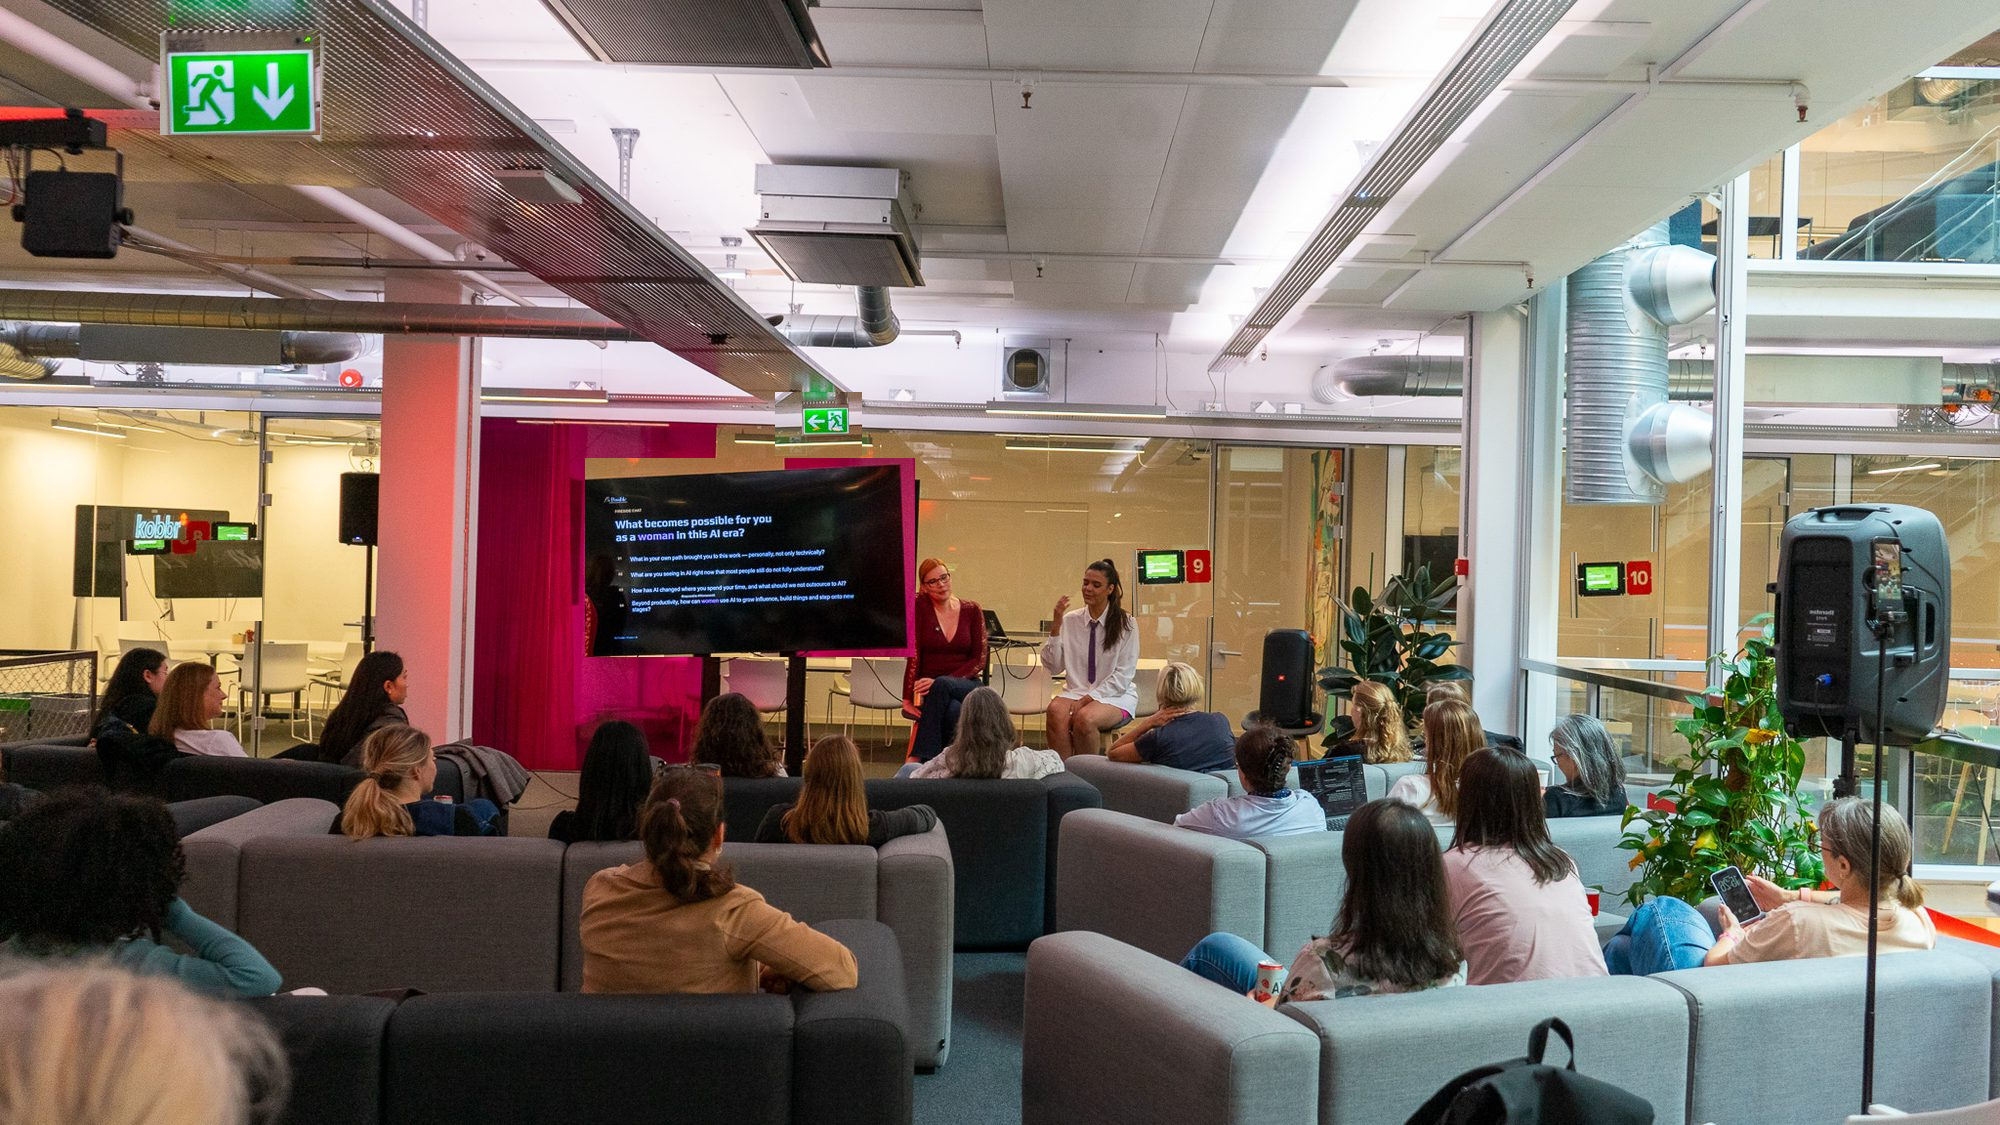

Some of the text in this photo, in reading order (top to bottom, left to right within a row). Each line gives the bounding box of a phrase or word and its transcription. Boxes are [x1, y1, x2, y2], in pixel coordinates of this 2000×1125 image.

[134, 513, 182, 539] kobbr
[615, 515, 772, 529] What becomes possible for you
[637, 532, 675, 541] woman
[676, 531, 686, 540] in
[687, 530, 708, 539] this
[709, 529, 720, 538] AI
[722, 528, 745, 538] era?
[1193, 558, 1204, 574] 9
[1630, 570, 1649, 586] 10
